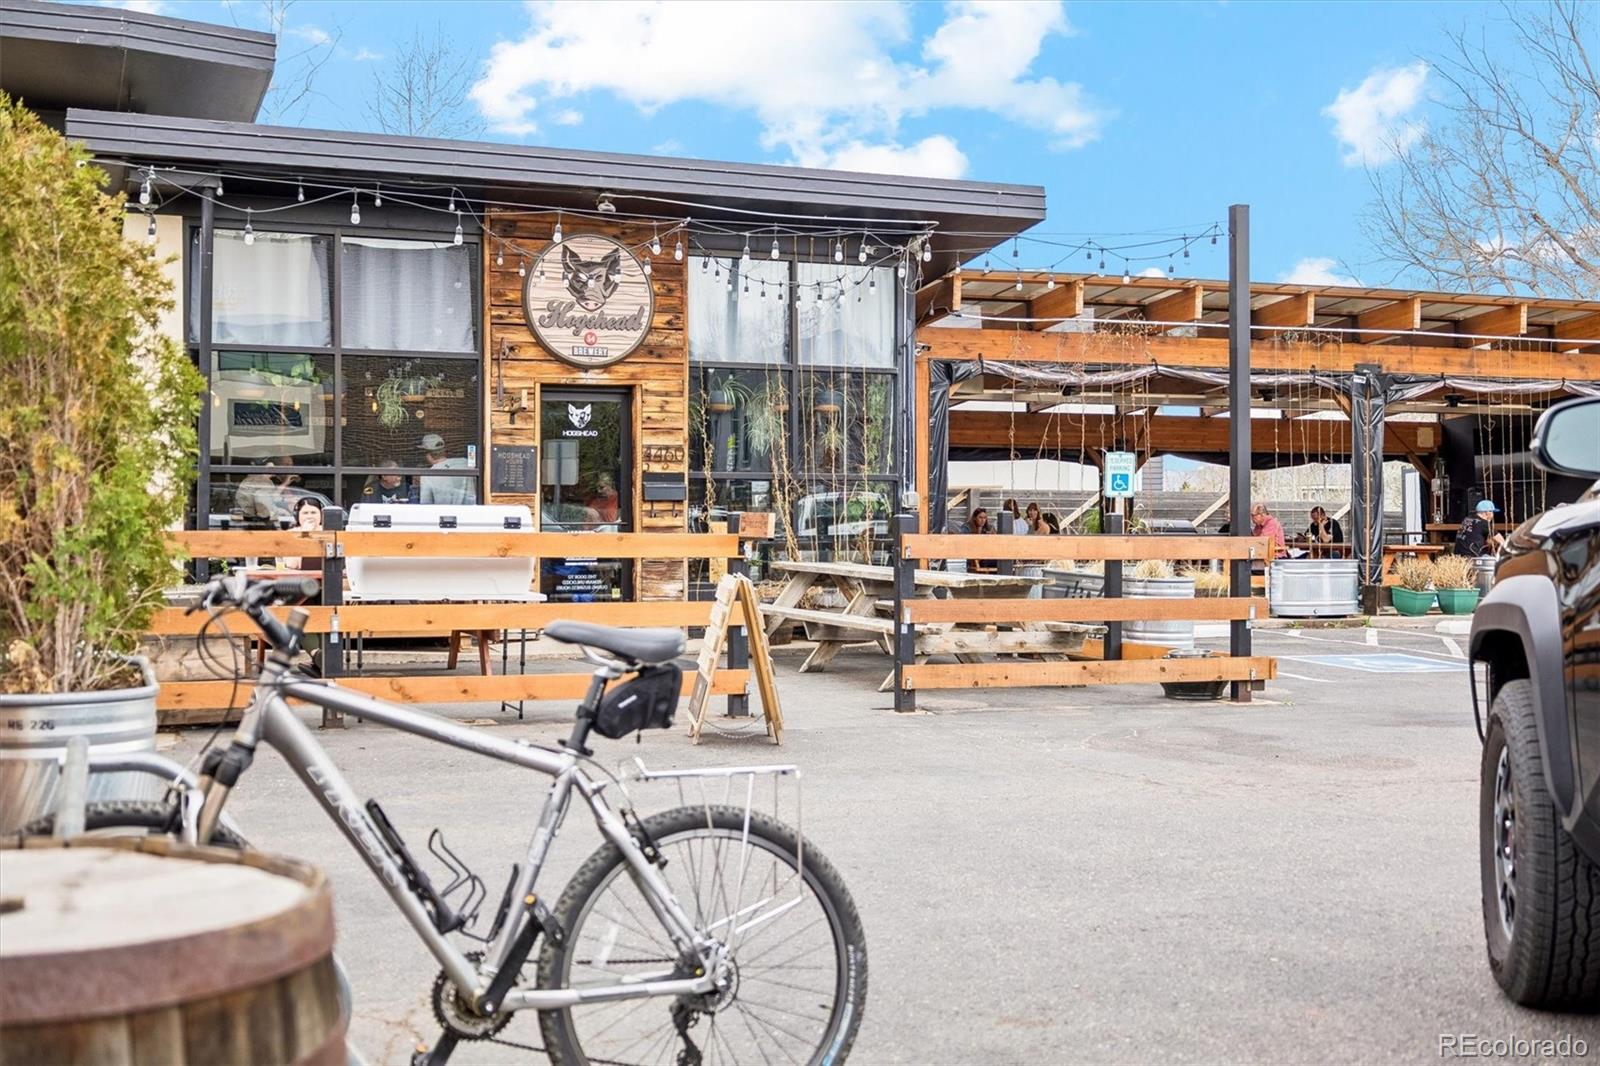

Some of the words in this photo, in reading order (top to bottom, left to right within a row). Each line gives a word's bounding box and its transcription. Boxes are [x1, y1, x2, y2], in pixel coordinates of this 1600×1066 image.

[539, 300, 645, 336] Hogshead
[573, 347, 608, 356] BREWERY
[643, 446, 685, 462] 4460
